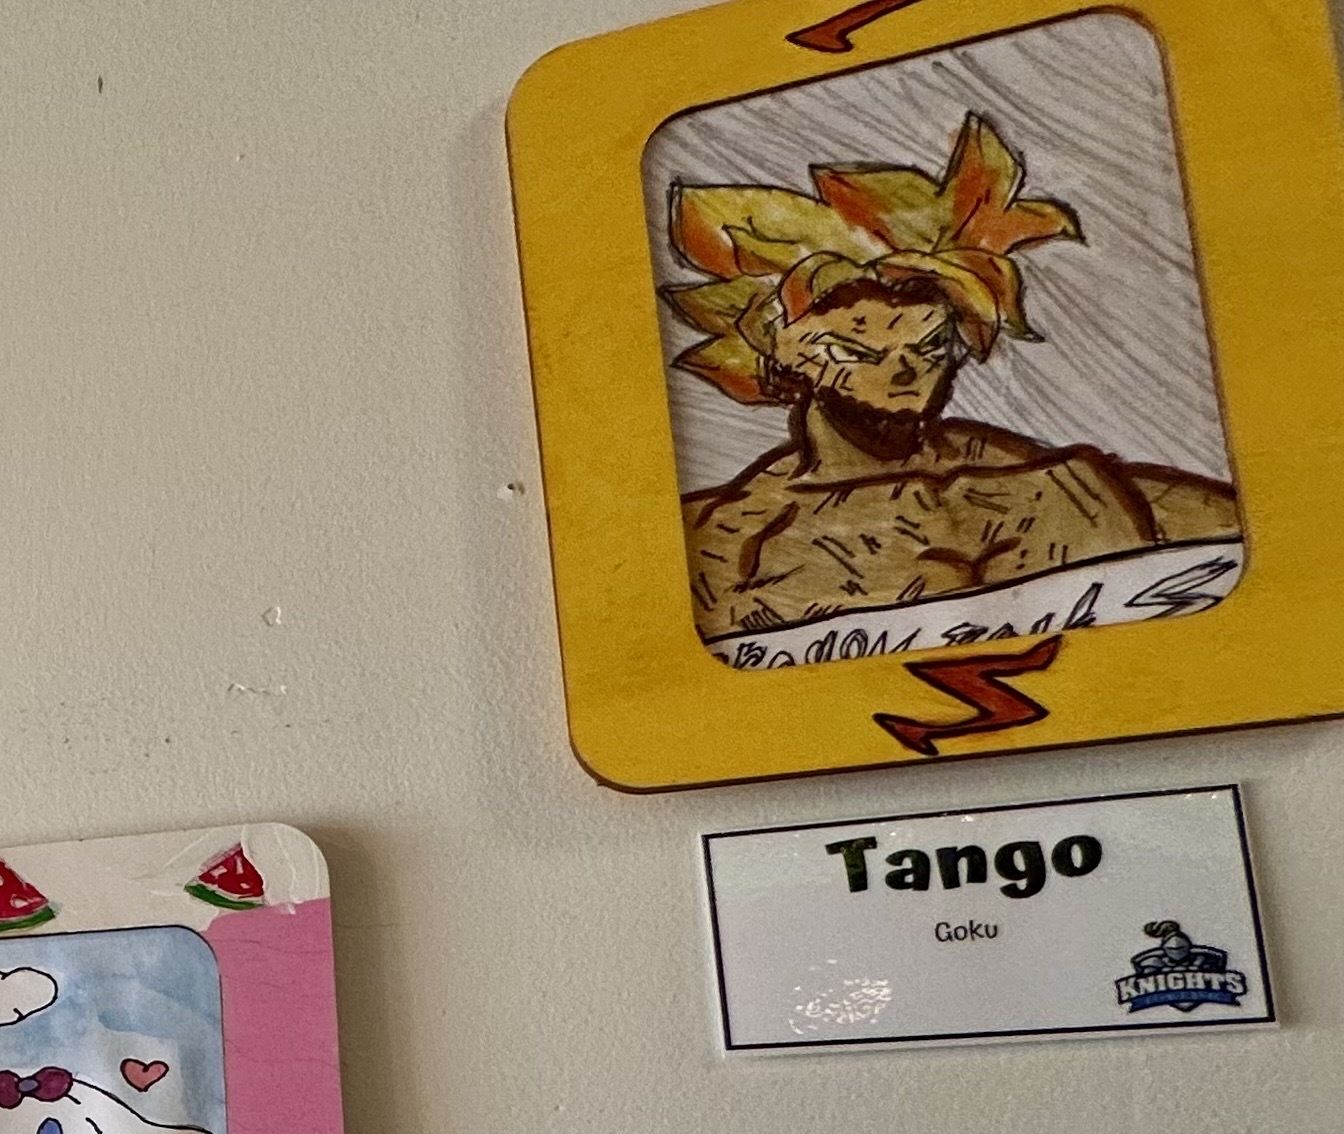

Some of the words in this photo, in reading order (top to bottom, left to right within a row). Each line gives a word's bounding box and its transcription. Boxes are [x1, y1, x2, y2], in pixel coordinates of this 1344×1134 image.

[825, 832, 1104, 900] Tango
[934, 920, 999, 943] Goku
[1118, 971, 1246, 1003] KNIGHTS
